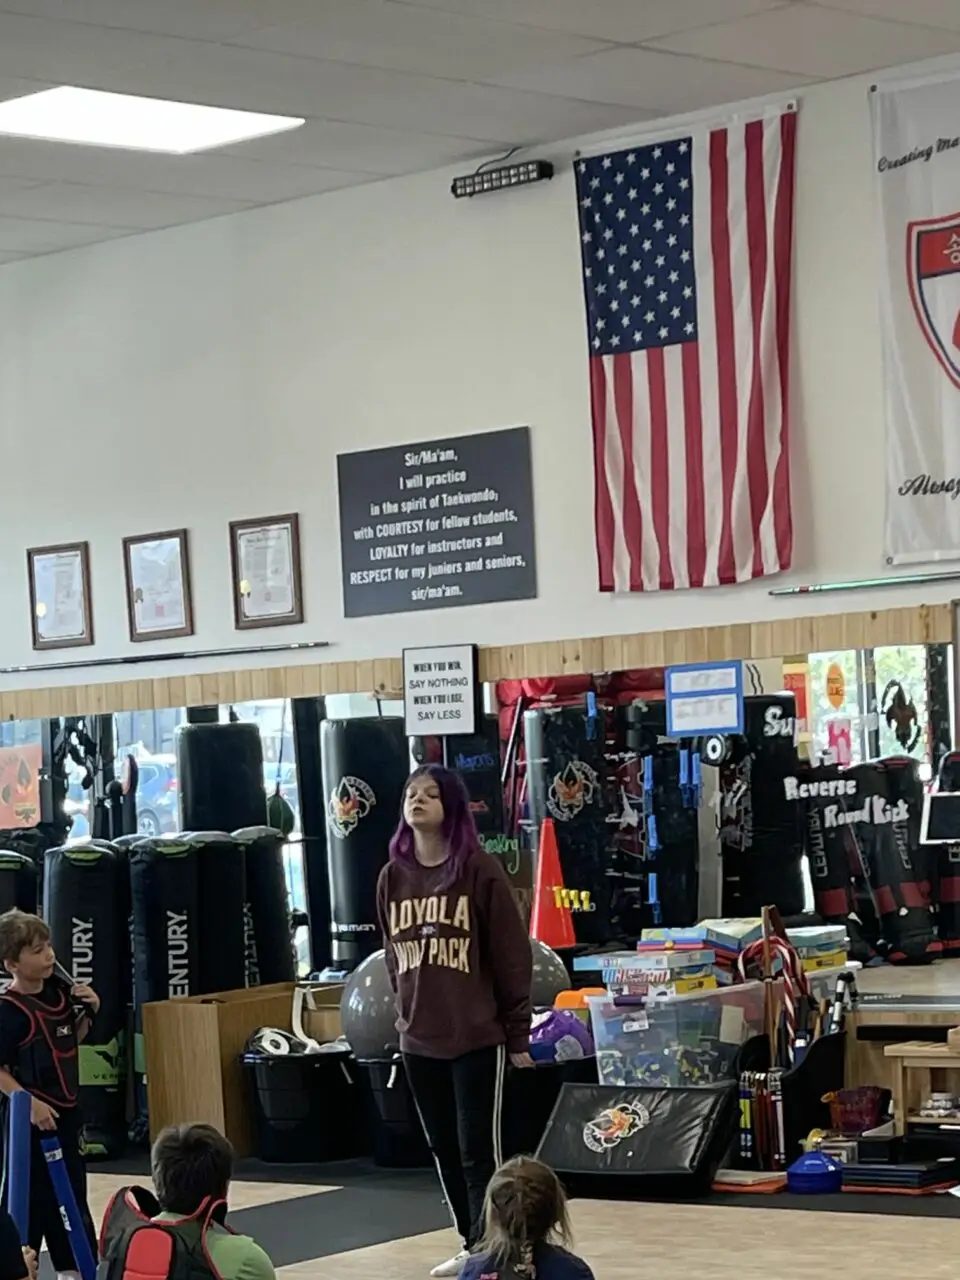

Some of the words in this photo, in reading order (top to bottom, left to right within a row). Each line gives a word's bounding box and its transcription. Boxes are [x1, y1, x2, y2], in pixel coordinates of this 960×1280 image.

[877, 145, 934, 173] Creating
[405, 474, 423, 489] will
[426, 470, 467, 488] practice
[370, 503, 380, 516] in
[382, 501, 398, 515] the
[401, 497, 427, 516] spirit
[429, 495, 439, 509] of
[353, 524, 374, 541] with
[376, 519, 424, 538] COURTESY
[426, 518, 439, 532] for
[442, 514, 471, 531] fellow
[473, 509, 518, 526] students,
[370, 544, 408, 561] LOYALTY
[411, 542, 425, 556] for
[427, 536, 482, 554] instructors
[485, 532, 503, 547] and
[350, 567, 392, 585] RESPECT
[395, 565, 408, 580] for
[411, 566, 425, 579] my
[427, 560, 462, 578] juniors
[465, 558, 483, 573] and
[485, 553, 526, 568] seniors,
[409, 680, 425, 689] SAY
[428, 677, 468, 688] NOTHING
[417, 711, 435, 721] SAY
[437, 709, 461, 720] LESS
[783, 775, 857, 801] Reverse
[389, 895, 470, 936] LOYOLA
[166, 910, 189, 1000] ENTURY
[428, 937, 470, 974] PACK
